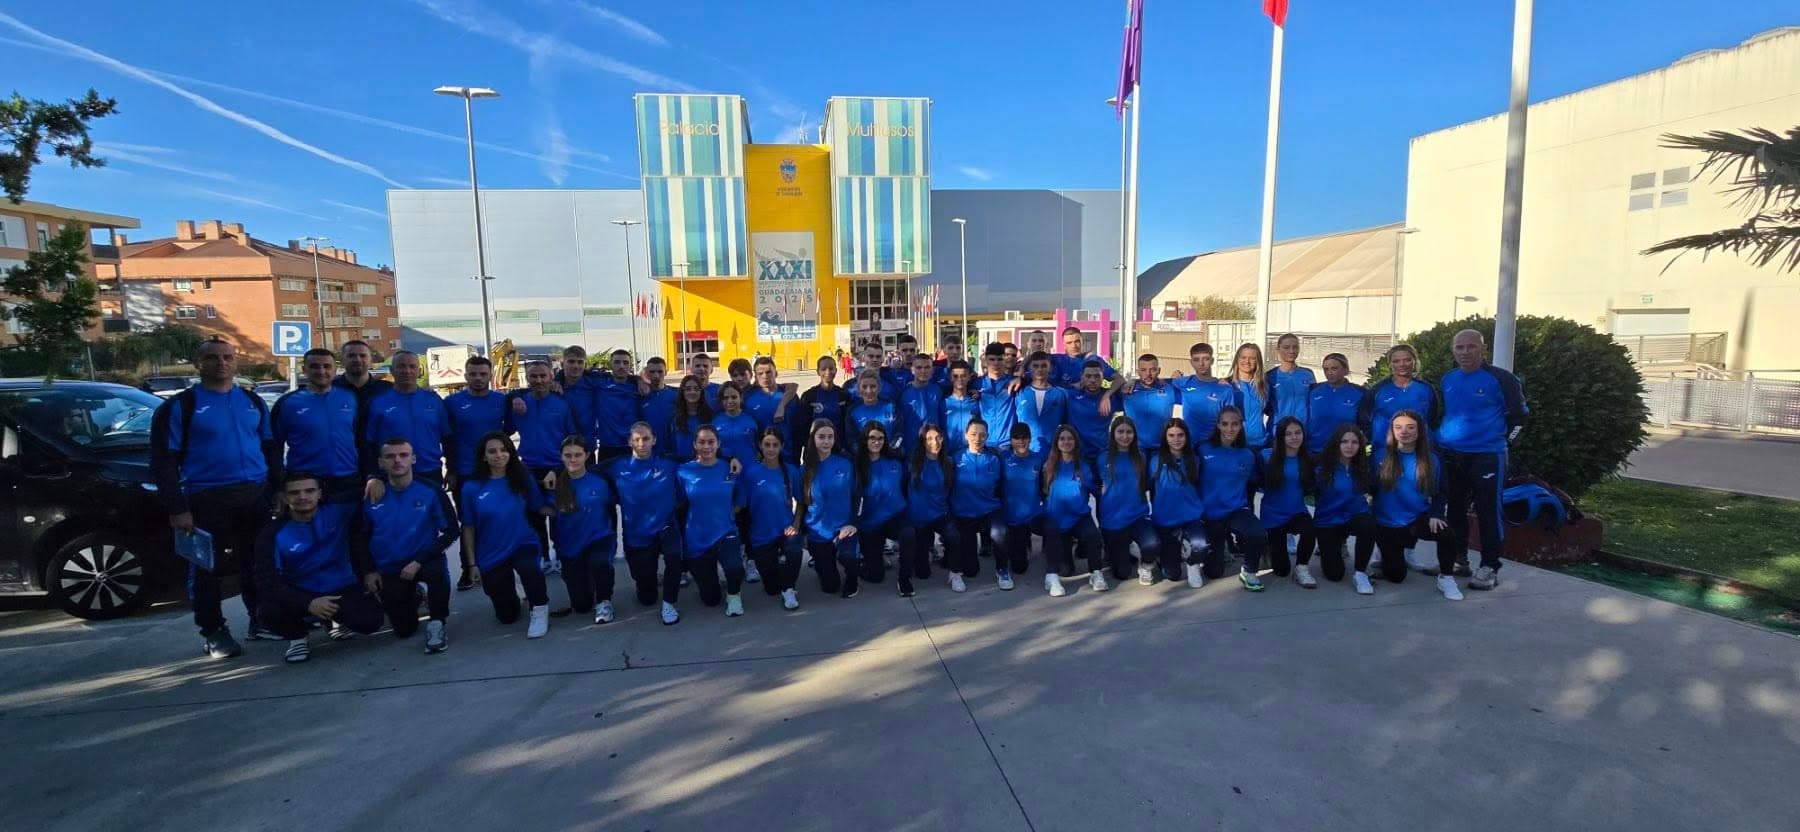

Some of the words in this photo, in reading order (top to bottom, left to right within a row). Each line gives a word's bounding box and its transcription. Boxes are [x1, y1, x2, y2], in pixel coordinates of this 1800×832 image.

[660, 120, 720, 136] Palacio
[847, 121, 915, 137] Multiusos
[758, 259, 812, 280] XXXI
[279, 325, 302, 352] P
